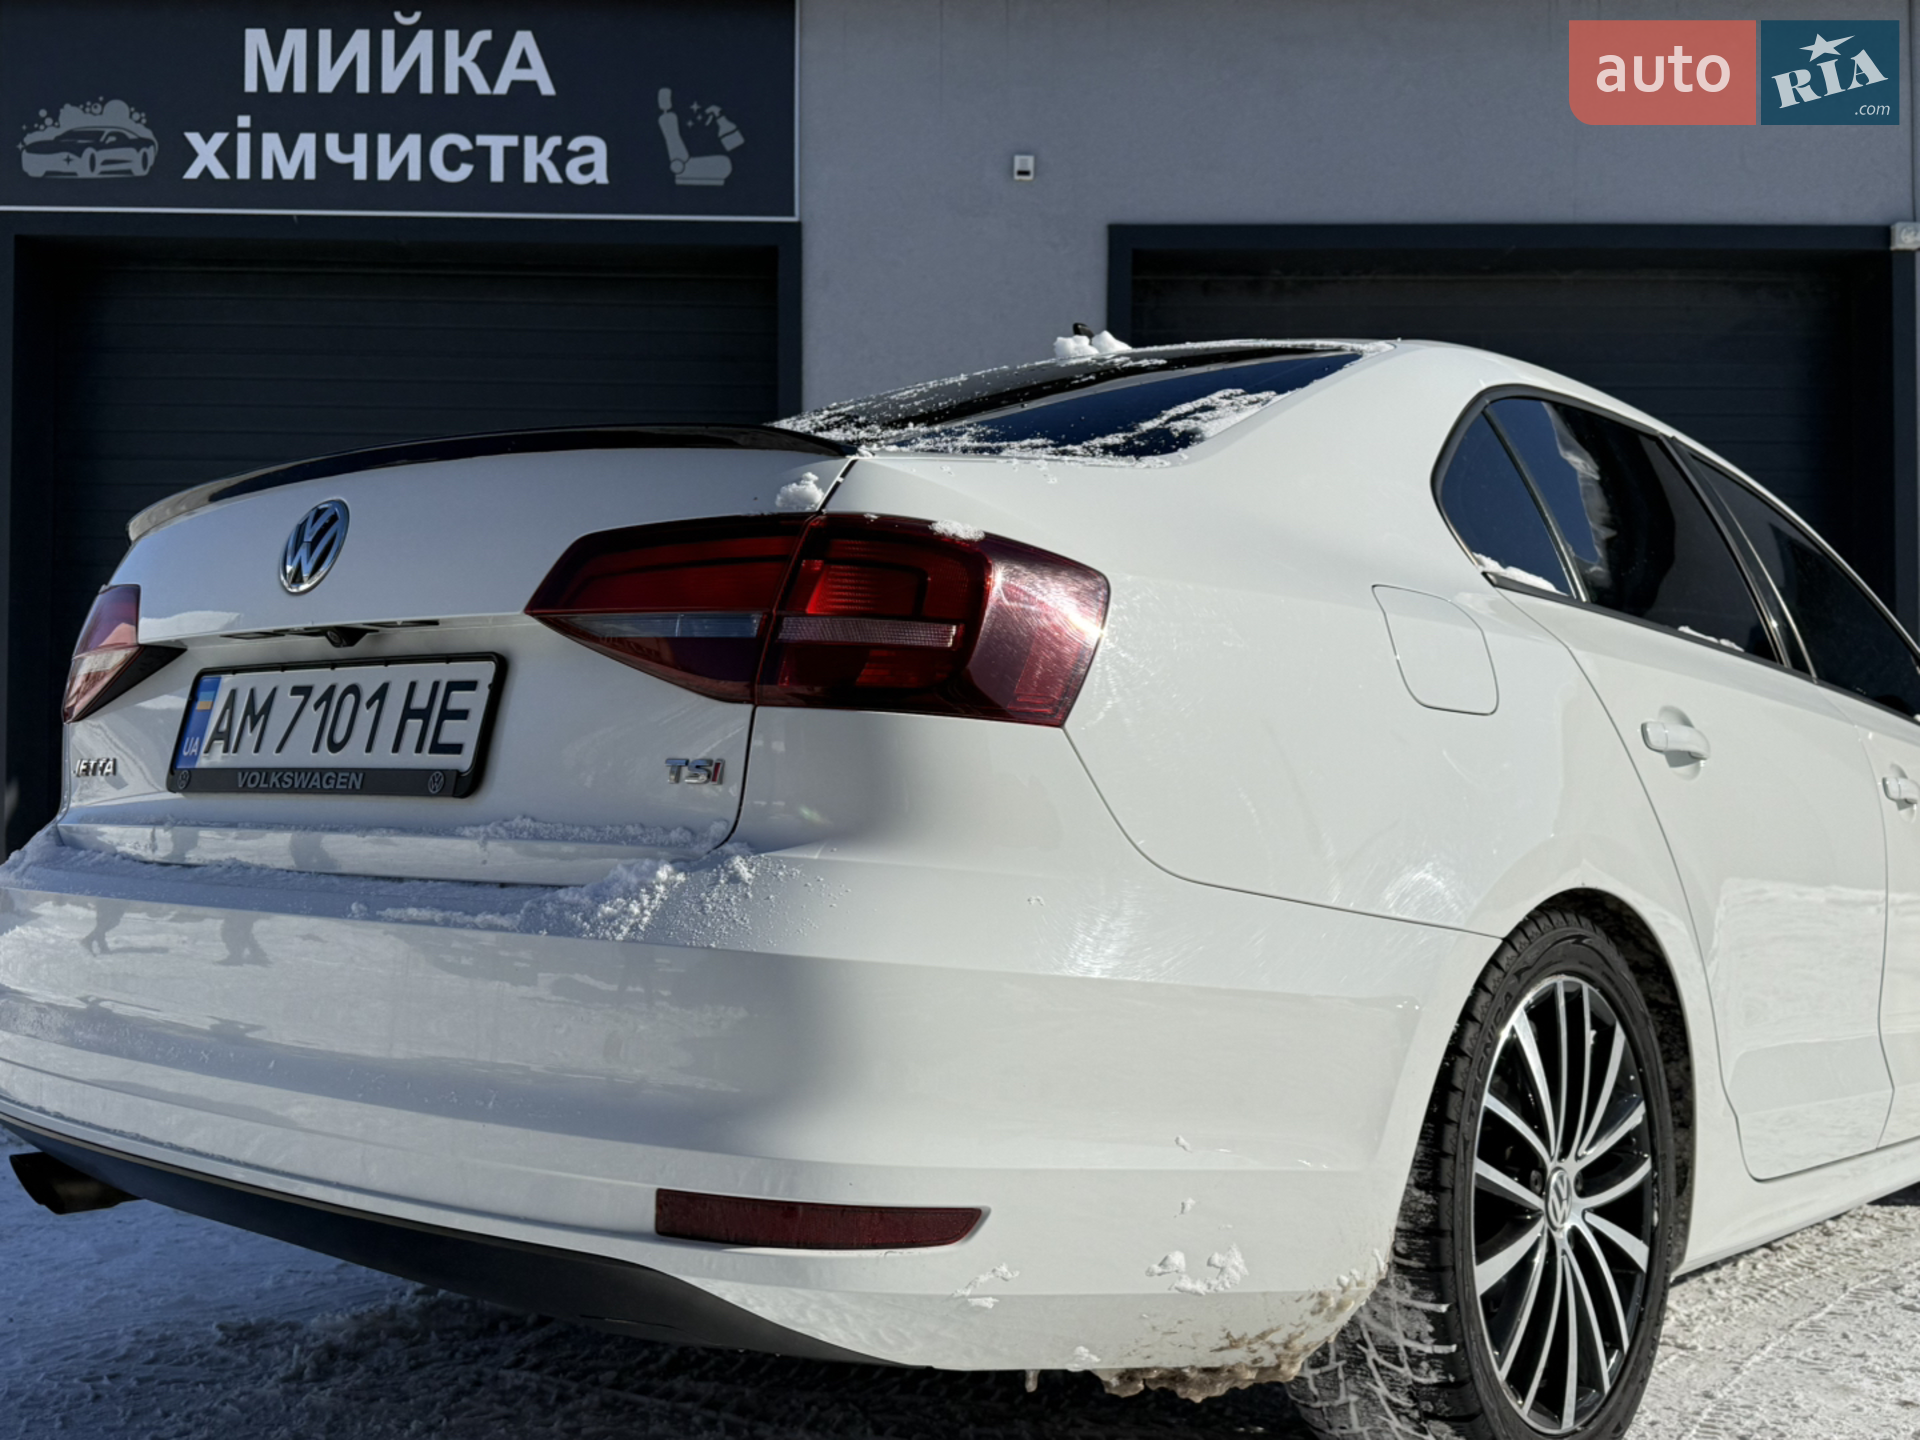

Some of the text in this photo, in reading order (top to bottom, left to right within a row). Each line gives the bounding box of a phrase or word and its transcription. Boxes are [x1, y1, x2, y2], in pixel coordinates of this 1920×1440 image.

[243, 10, 557, 97] МИЙКА
[181, 115, 609, 186] хімчистка
[183, 736, 200, 756] UA
[237, 771, 364, 790] VOLKSWAGEN
[665, 758, 725, 785] TSI
